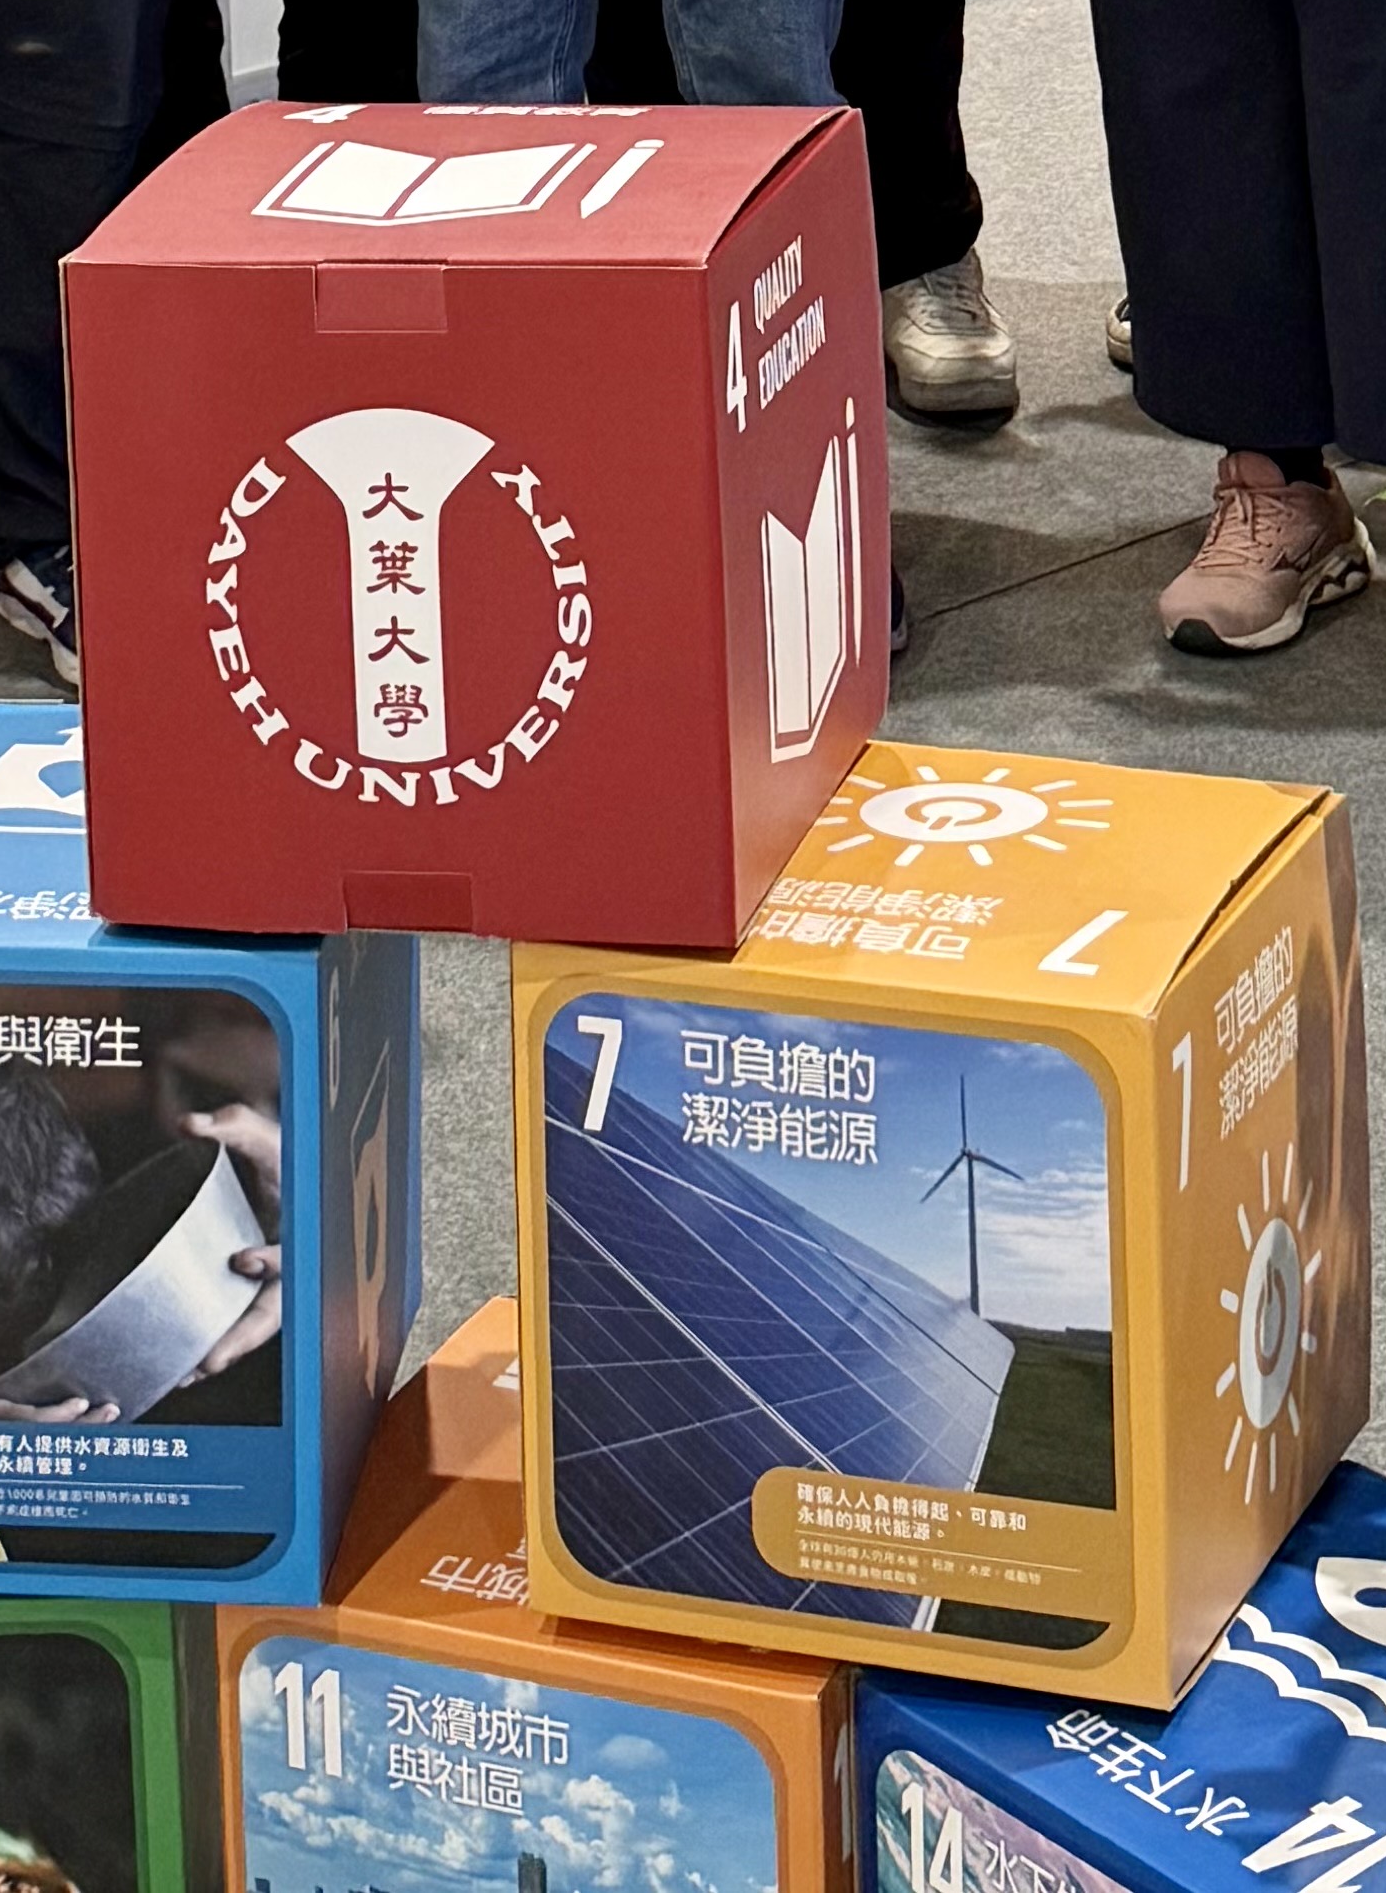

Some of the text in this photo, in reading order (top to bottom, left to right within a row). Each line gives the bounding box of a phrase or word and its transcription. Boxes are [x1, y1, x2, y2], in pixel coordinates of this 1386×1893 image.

[752, 233, 804, 332] QUALITY
[726, 300, 747, 433] 4
[758, 295, 826, 411] EDUCATION
[205, 455, 593, 807] DAYEH UNIVERSITY
[362, 470, 429, 737] 大葉大學
[1213, 924, 1295, 1054] 可負擔的
[575, 1013, 624, 1133] 7
[679, 1027, 877, 1104] 可負擔的
[1172, 1031, 1195, 1192] 7
[1218, 999, 1301, 1143] 潔淨能源
[679, 1090, 880, 1166] 潔淨能源
[272, 1660, 345, 1779] 11
[384, 1684, 572, 1763] 永續城市
[385, 1747, 525, 1816] 與社區
[901, 1781, 963, 1893] 14
[984, 1839, 1078, 1893] 水下
